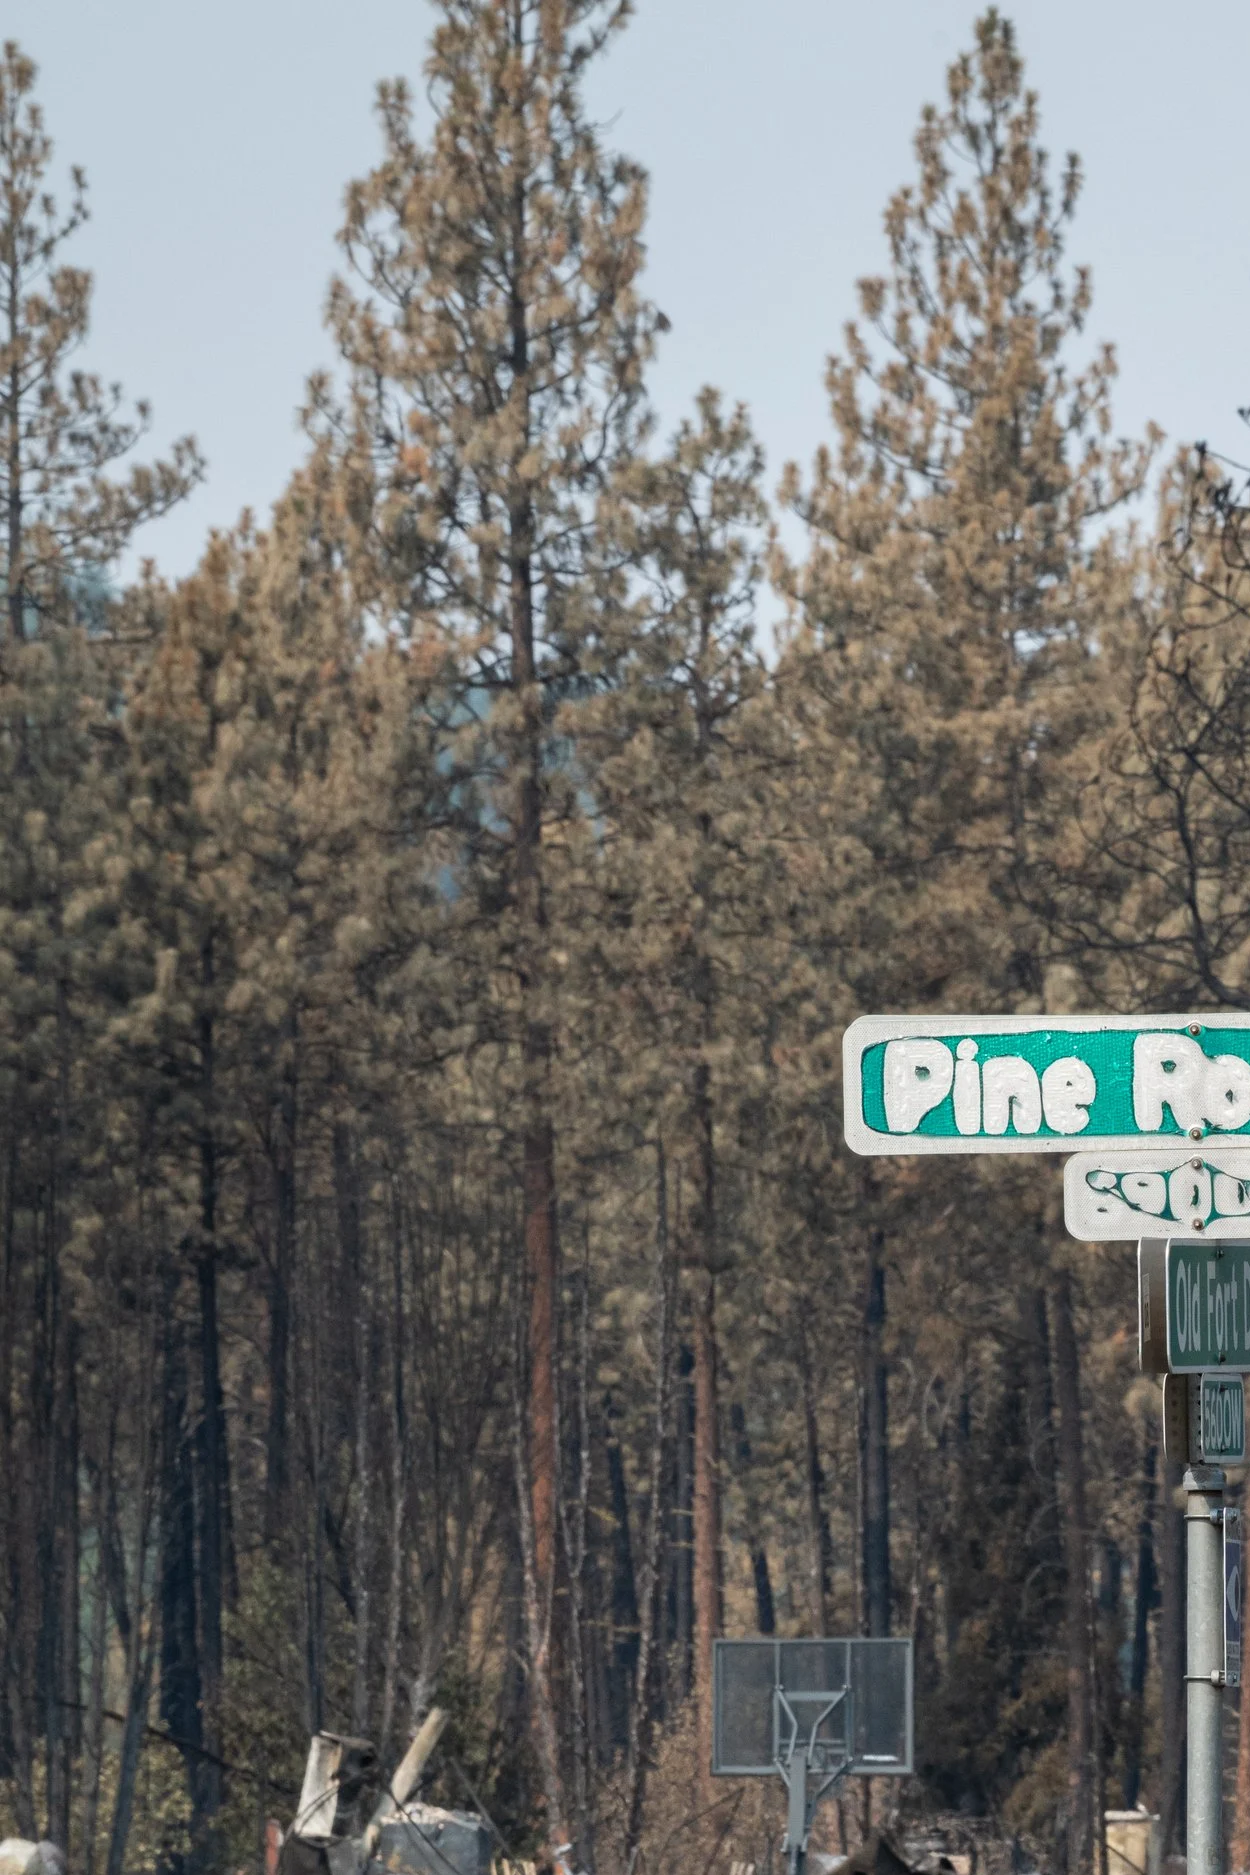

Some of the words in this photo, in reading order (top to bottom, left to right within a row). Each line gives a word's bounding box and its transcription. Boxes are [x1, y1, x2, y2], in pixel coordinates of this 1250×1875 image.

[884, 1036, 1097, 1136] Pine
[1176, 1259, 1201, 1352] Old
[1206, 1260, 1239, 1351] Fort
